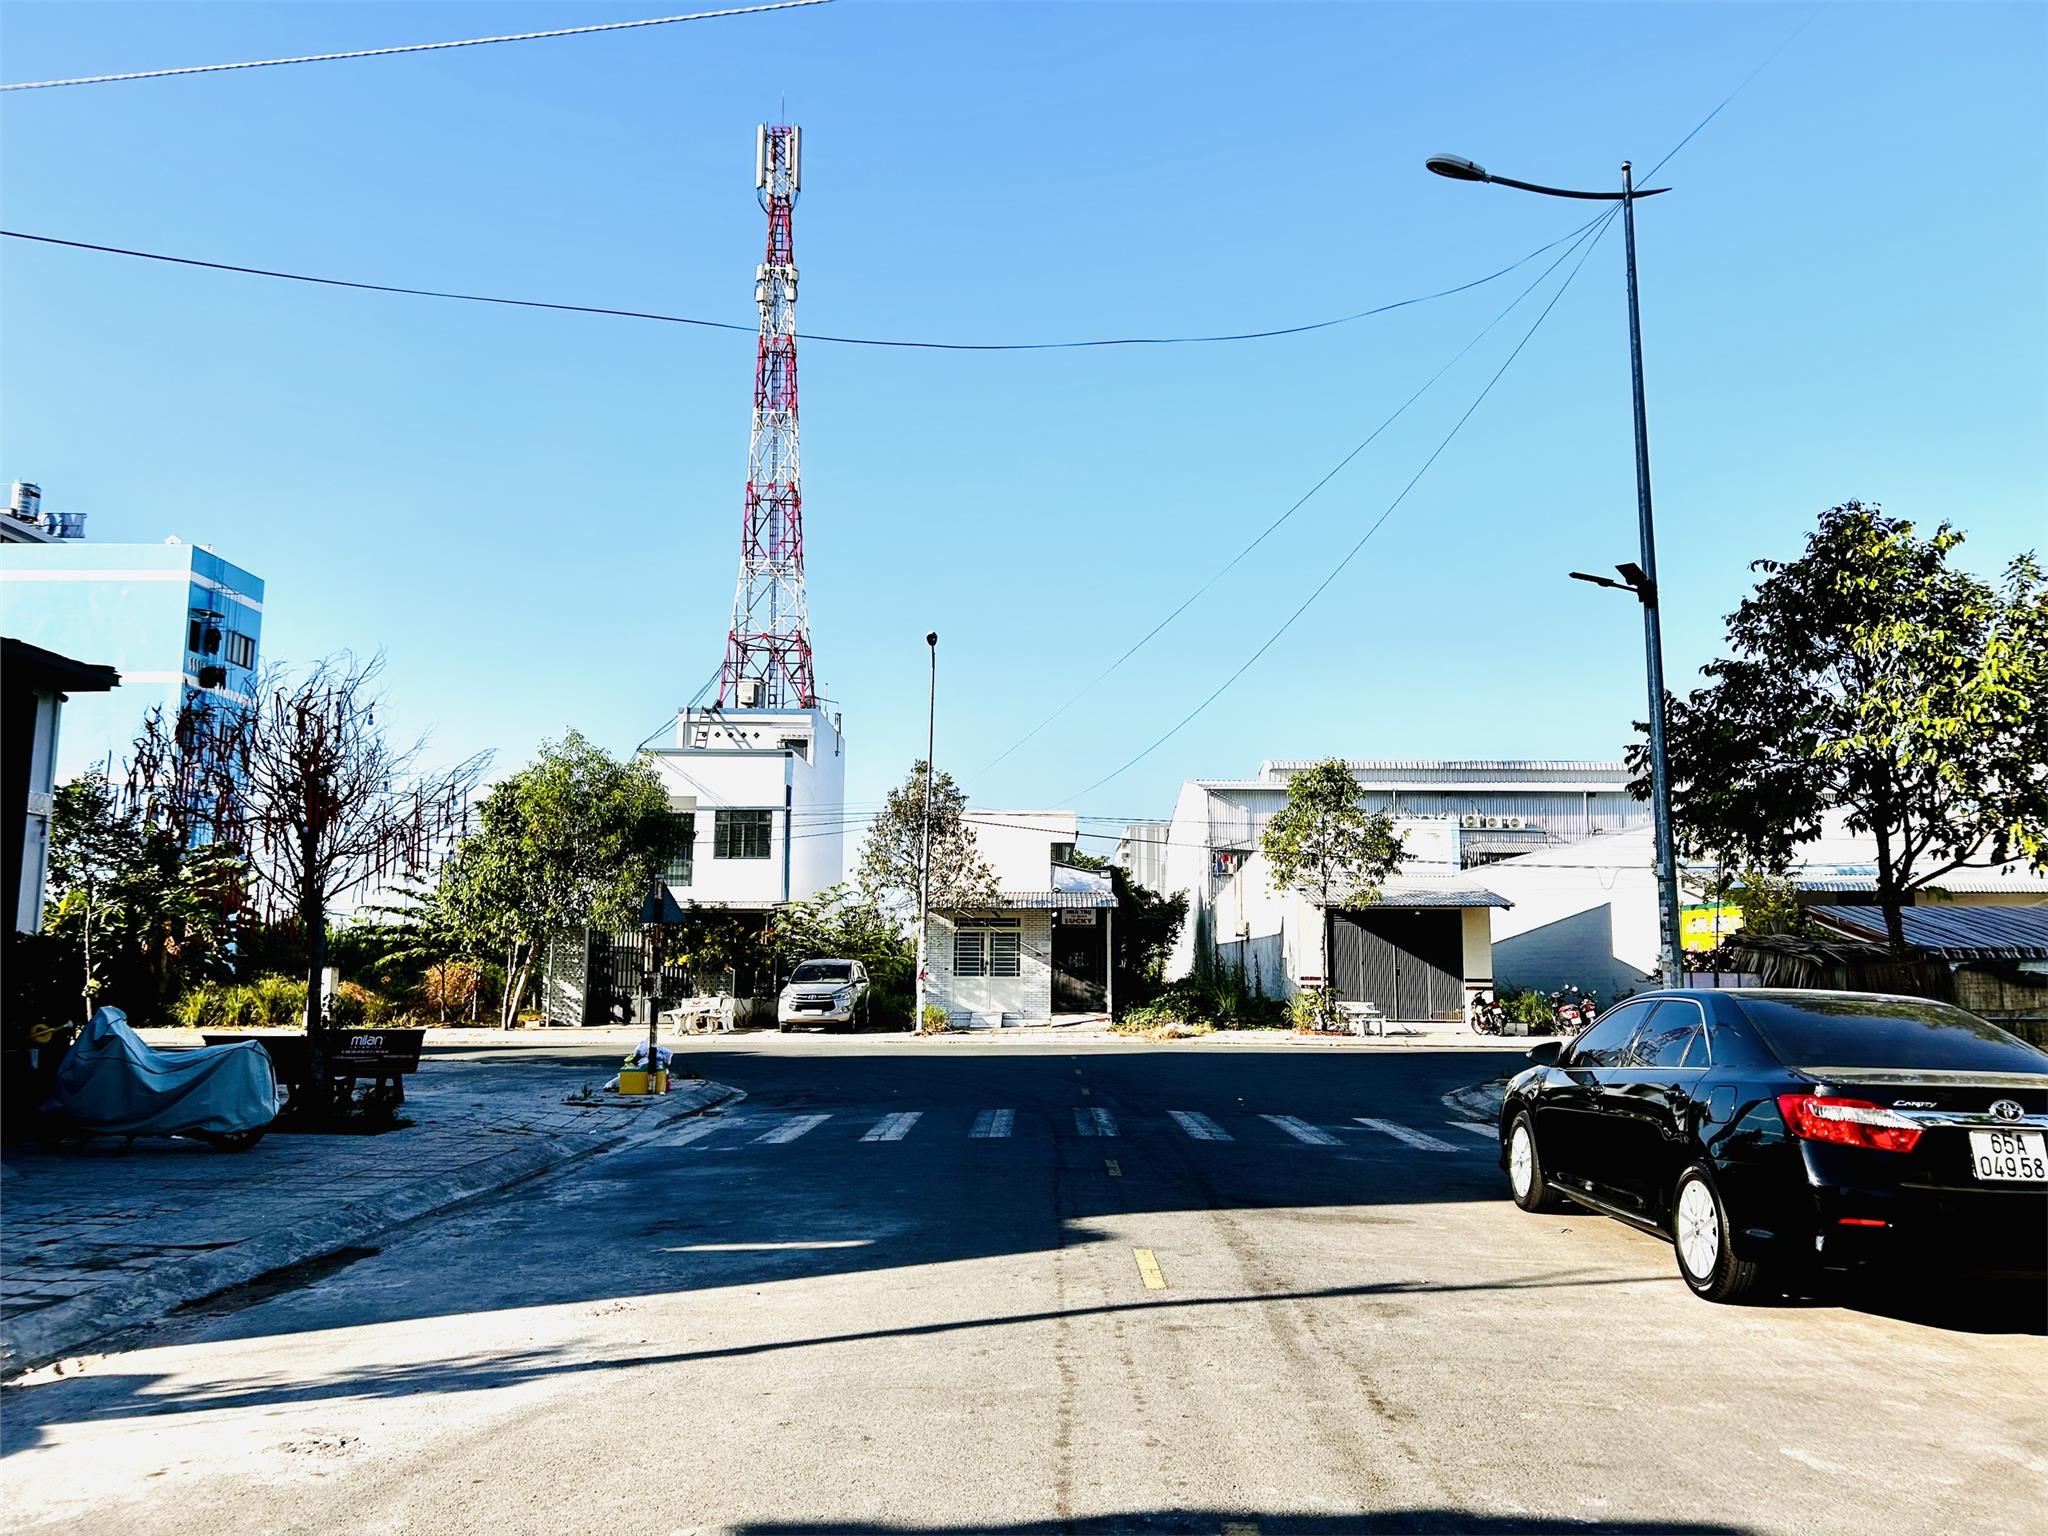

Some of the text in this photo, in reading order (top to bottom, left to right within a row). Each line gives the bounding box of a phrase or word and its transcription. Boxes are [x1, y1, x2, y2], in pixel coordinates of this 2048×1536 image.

[351, 1034, 383, 1046] milan
[1991, 1133, 2027, 1155] 65A
[1980, 1156, 2045, 1179] 049.58
